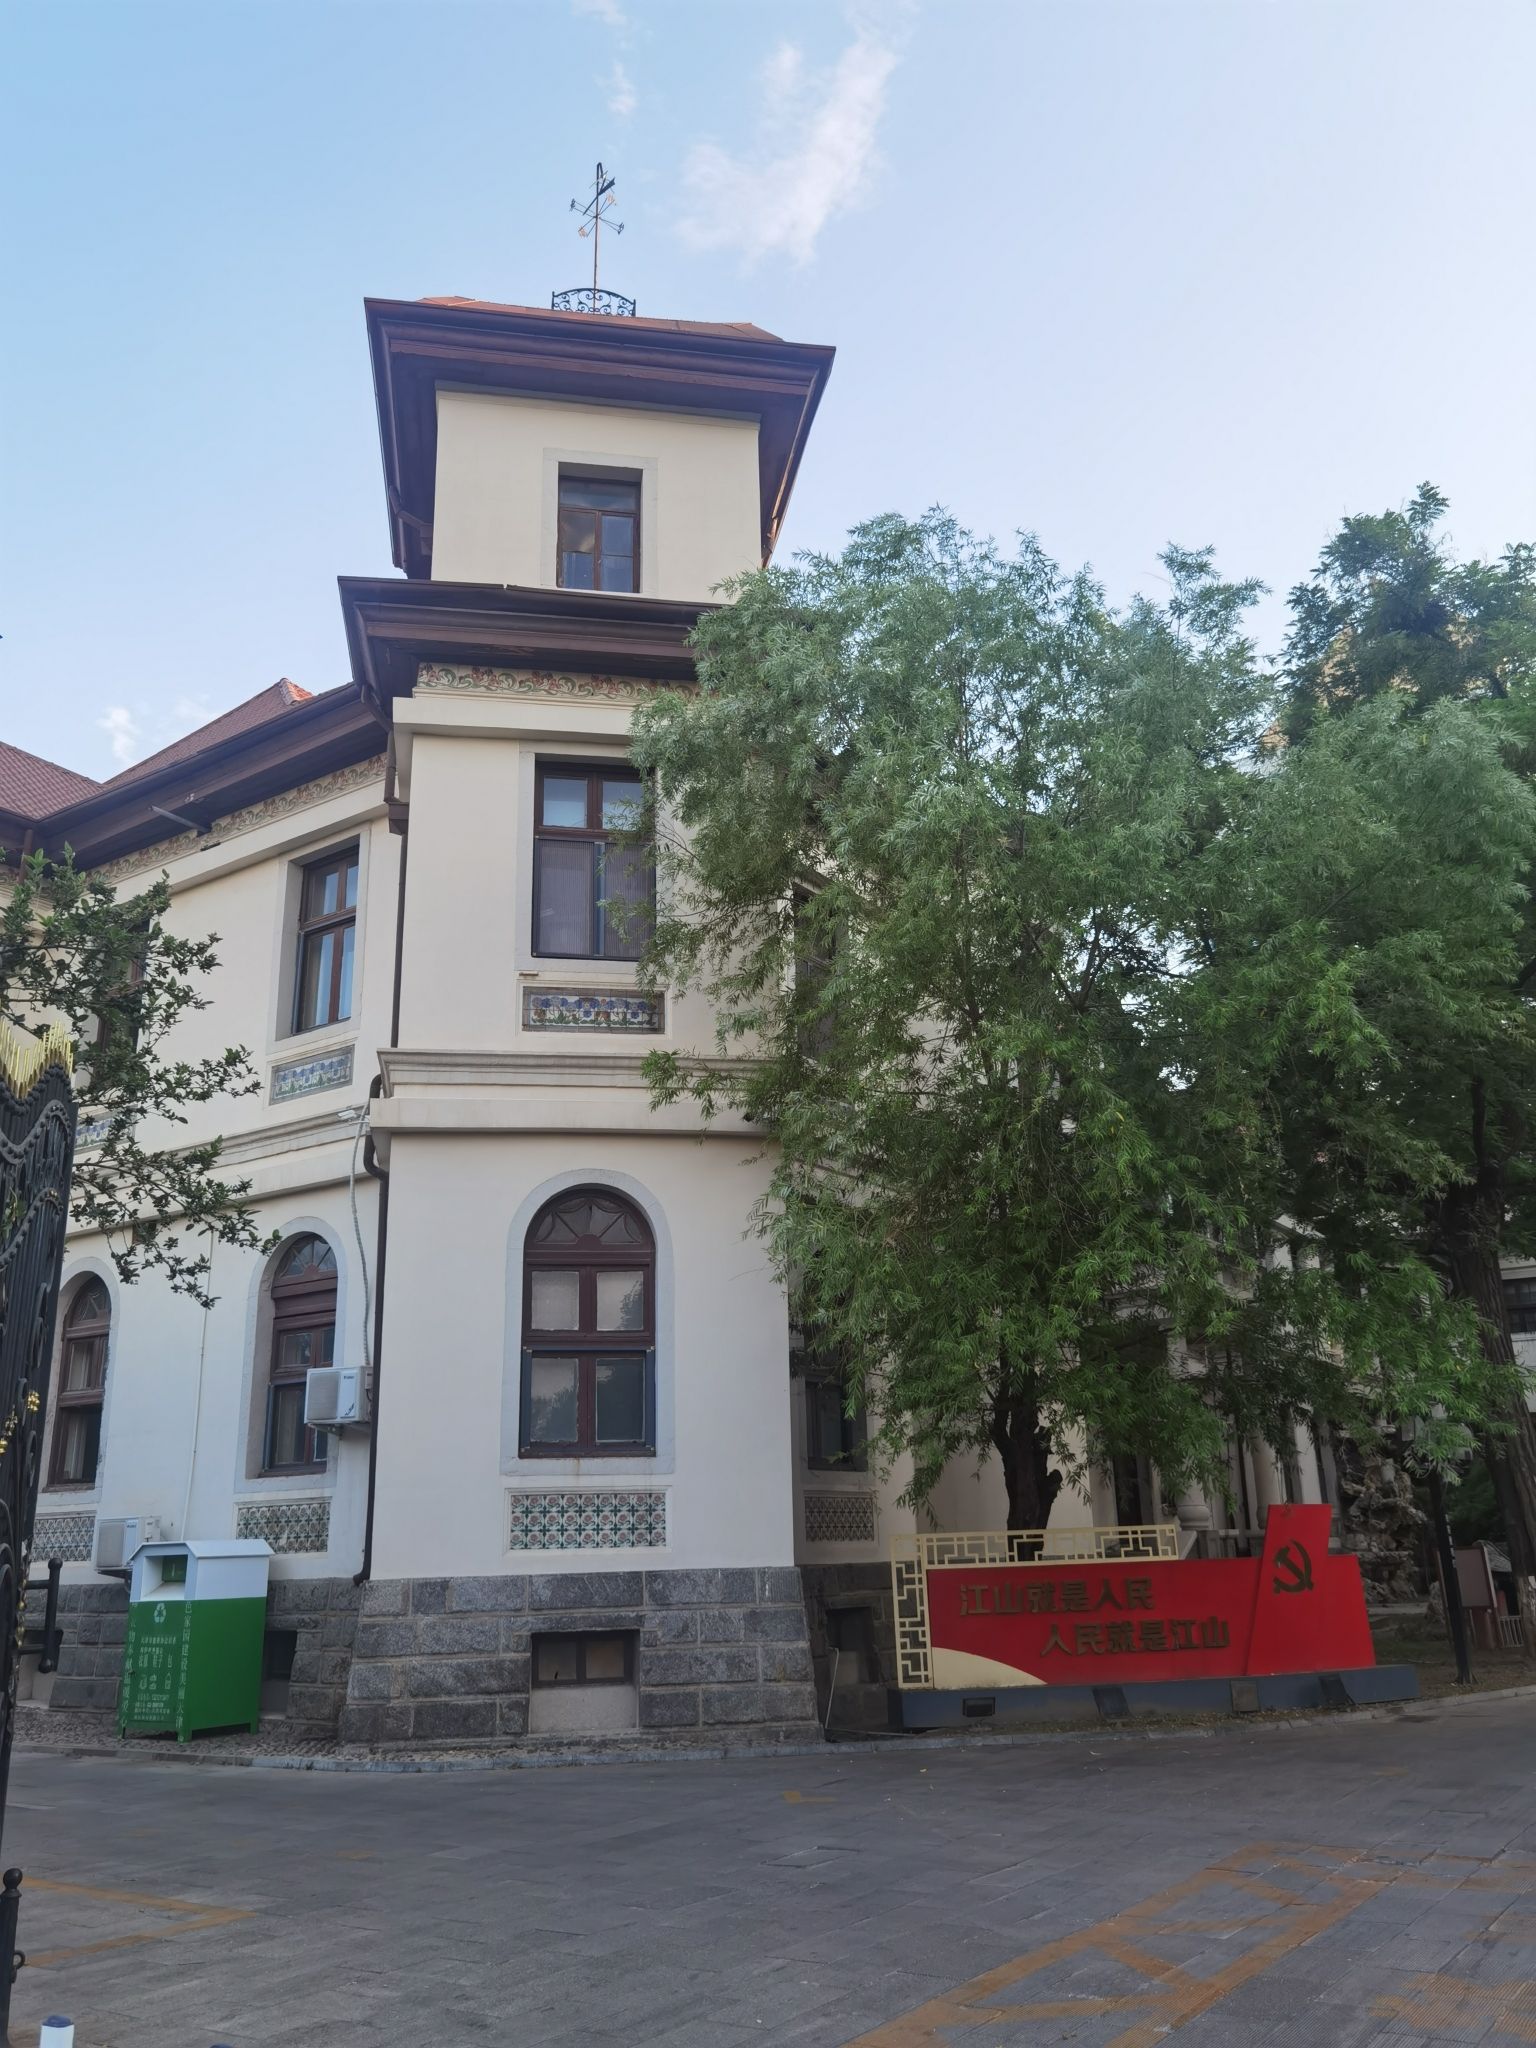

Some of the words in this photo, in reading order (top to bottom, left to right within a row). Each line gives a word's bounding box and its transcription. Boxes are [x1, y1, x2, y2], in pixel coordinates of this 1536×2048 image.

[960, 1577, 1155, 1616] 江山就是人民
[1040, 1616, 1230, 1657] 人民就是江山
